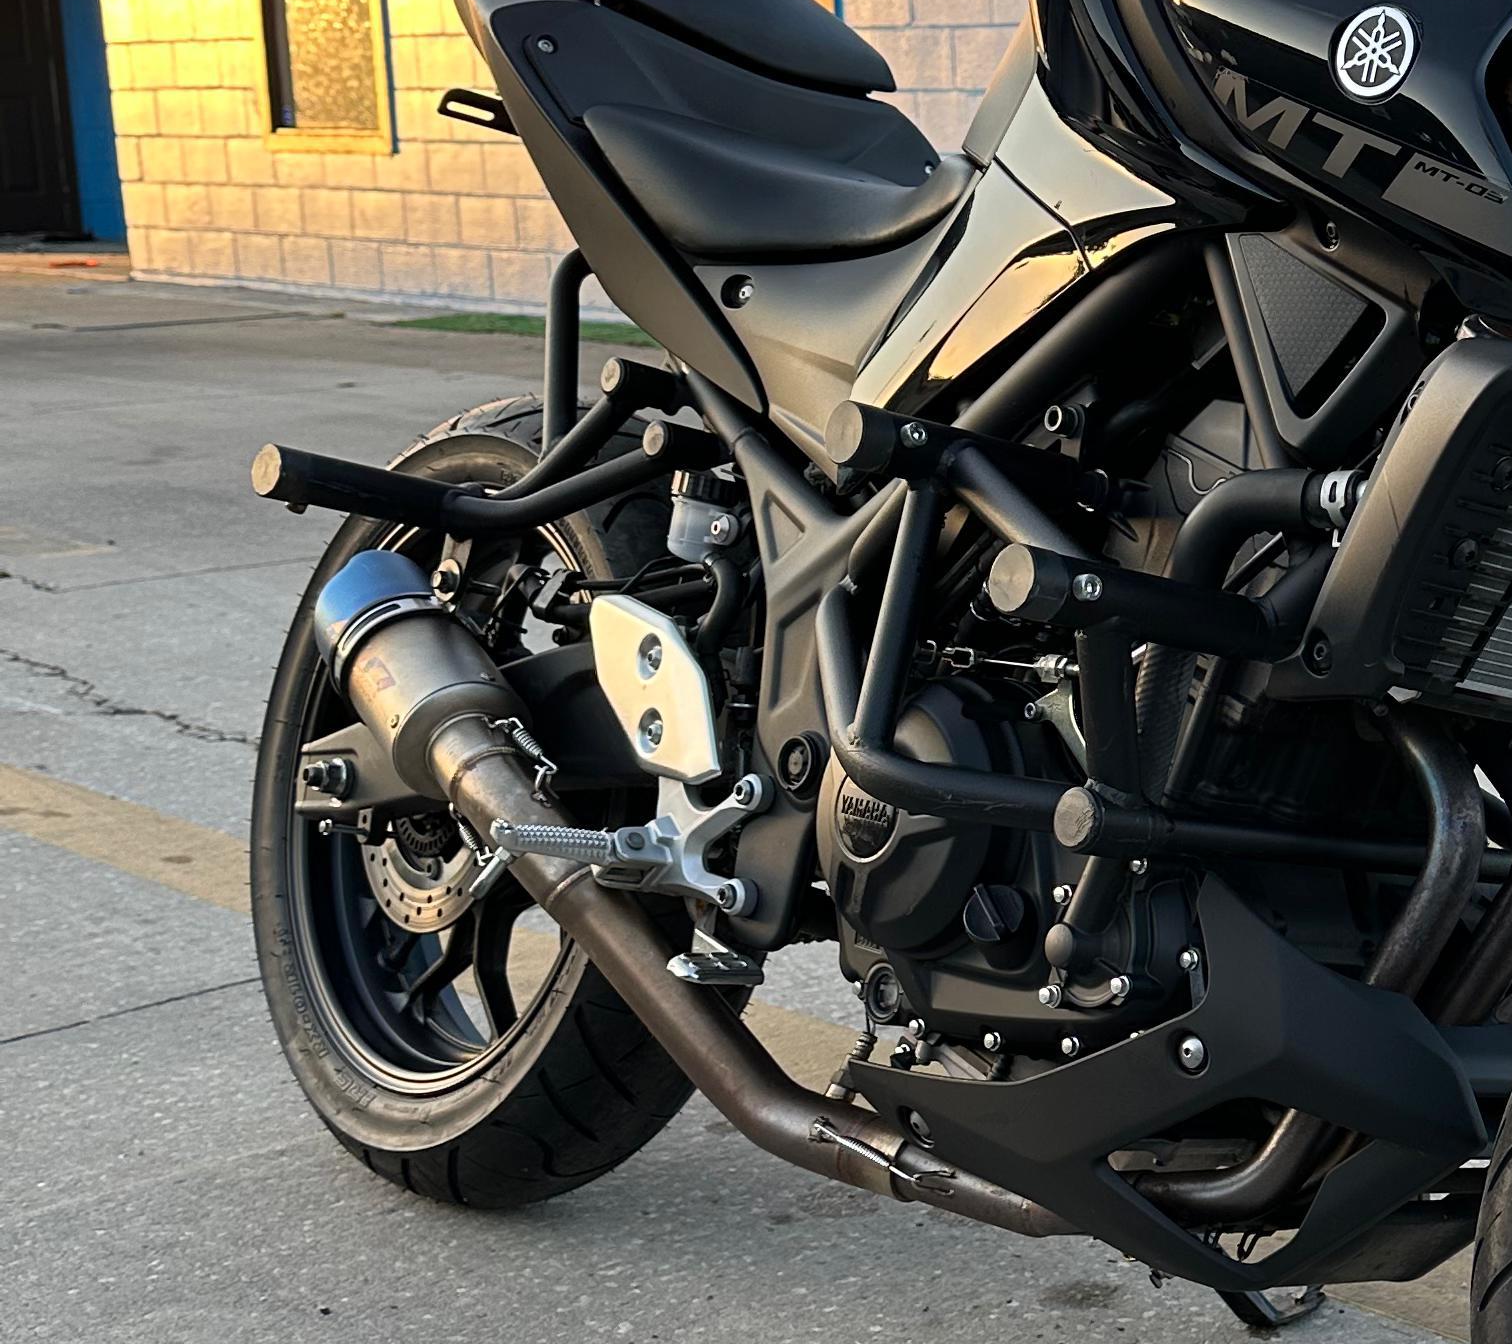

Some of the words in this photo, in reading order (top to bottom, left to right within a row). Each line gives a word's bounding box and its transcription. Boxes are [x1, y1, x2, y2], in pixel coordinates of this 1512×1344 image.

[1213, 67, 1402, 178] MT
[1414, 160, 1508, 205] MT-03
[841, 794, 890, 826] YAMAHA
